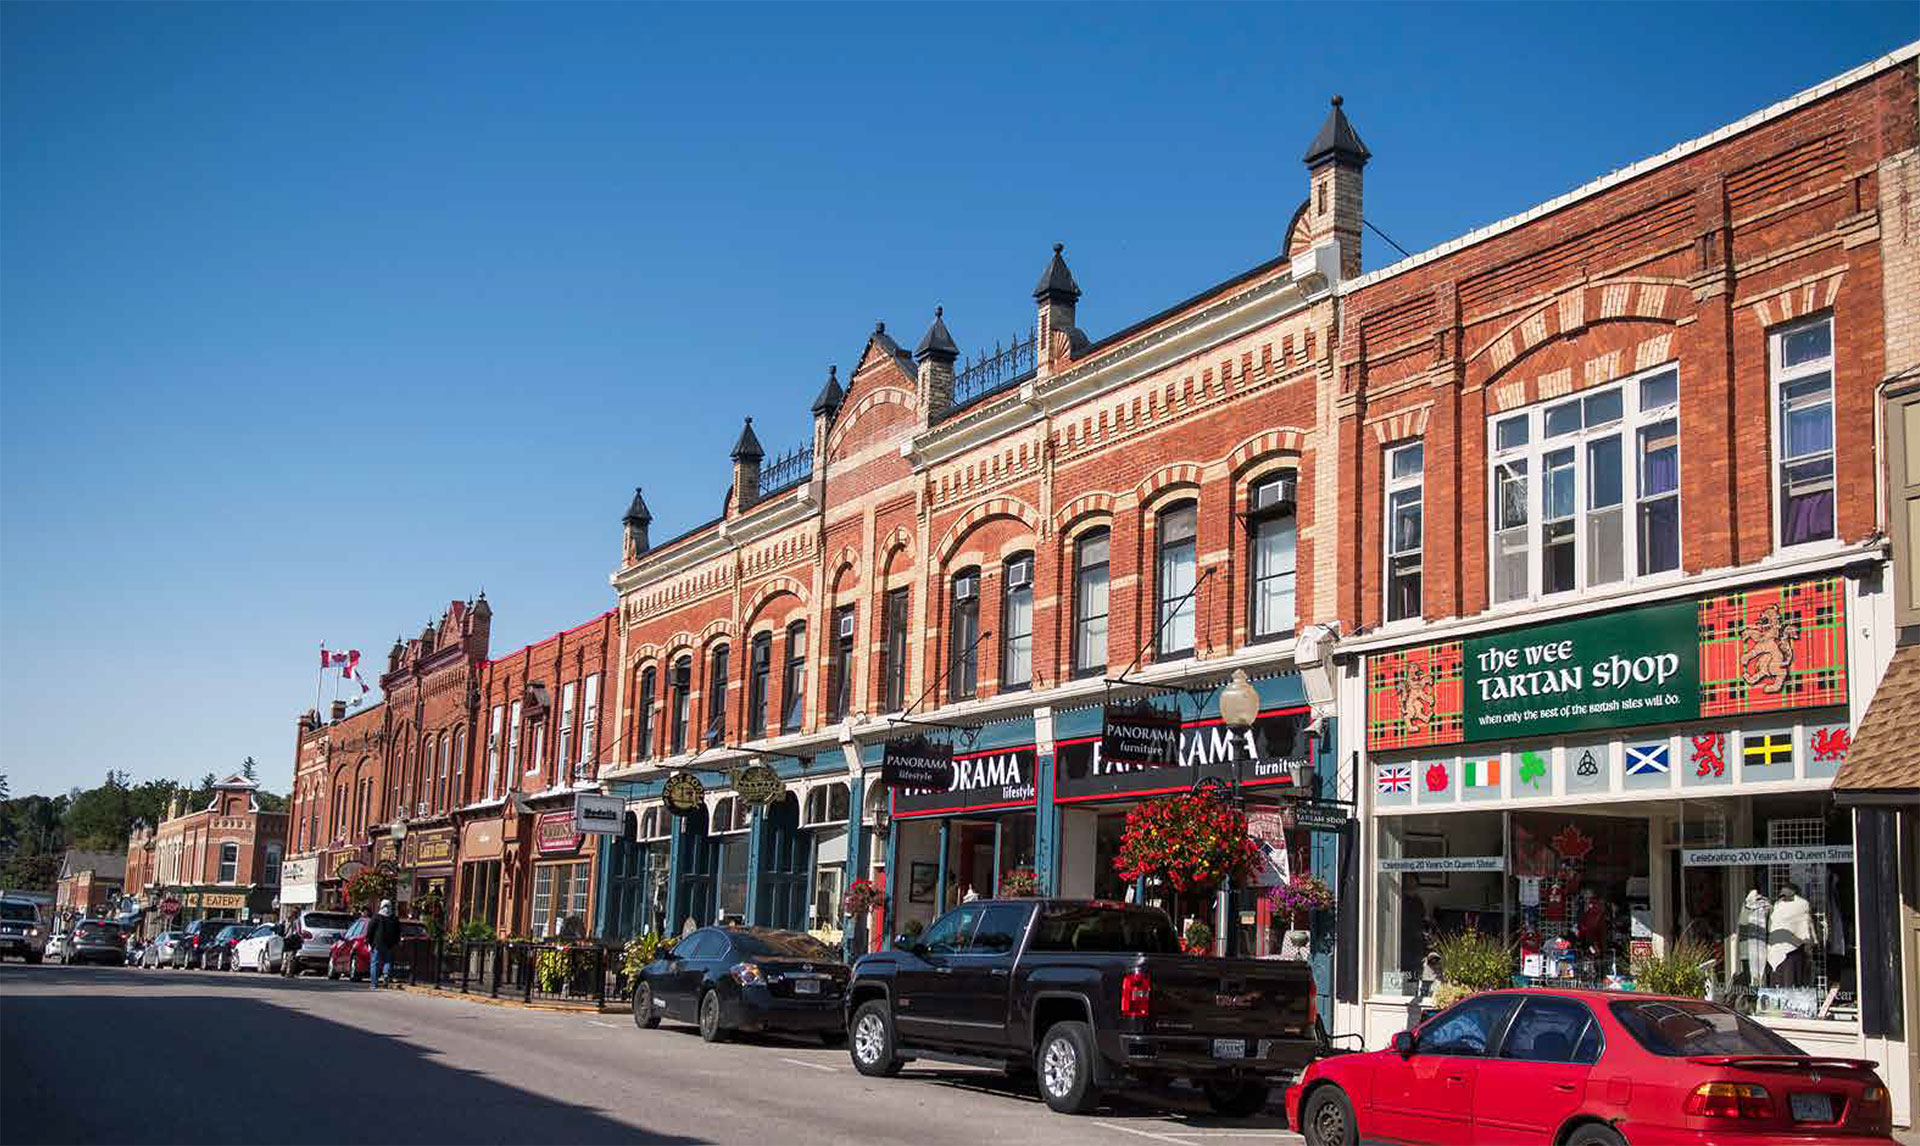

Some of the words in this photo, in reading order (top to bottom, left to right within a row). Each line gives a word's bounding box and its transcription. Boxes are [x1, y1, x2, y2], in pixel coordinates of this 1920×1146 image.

[1477, 666, 1583, 702] TARTAN
[1503, 711, 1523, 725] only
[1524, 710, 1539, 721] the
[1560, 704, 1571, 719] of
[1572, 704, 1588, 715] the
[1644, 694, 1663, 706] will
[1107, 724, 1176, 742] PANORAMA
[1092, 727, 1258, 776] PRAMA
[1120, 739, 1164, 757] furniture
[887, 754, 948, 770] PANORAMA
[1255, 757, 1310, 776] furnit
[899, 769, 933, 782] lifestyle
[1003, 783, 1035, 800] lifestyle
[1415, 860, 1424, 869] 20
[1424, 860, 1442, 869] Years
[1454, 859, 1475, 869] Queen
[1690, 852, 1737, 863] Celebrating
[1738, 851, 1750, 861] 20
[1752, 851, 1777, 861] Years
[1779, 850, 1793, 860] On
[1795, 849, 1826, 860] Queen
[162, 903, 180, 912] STOP
[206, 894, 241, 906] EATERY
